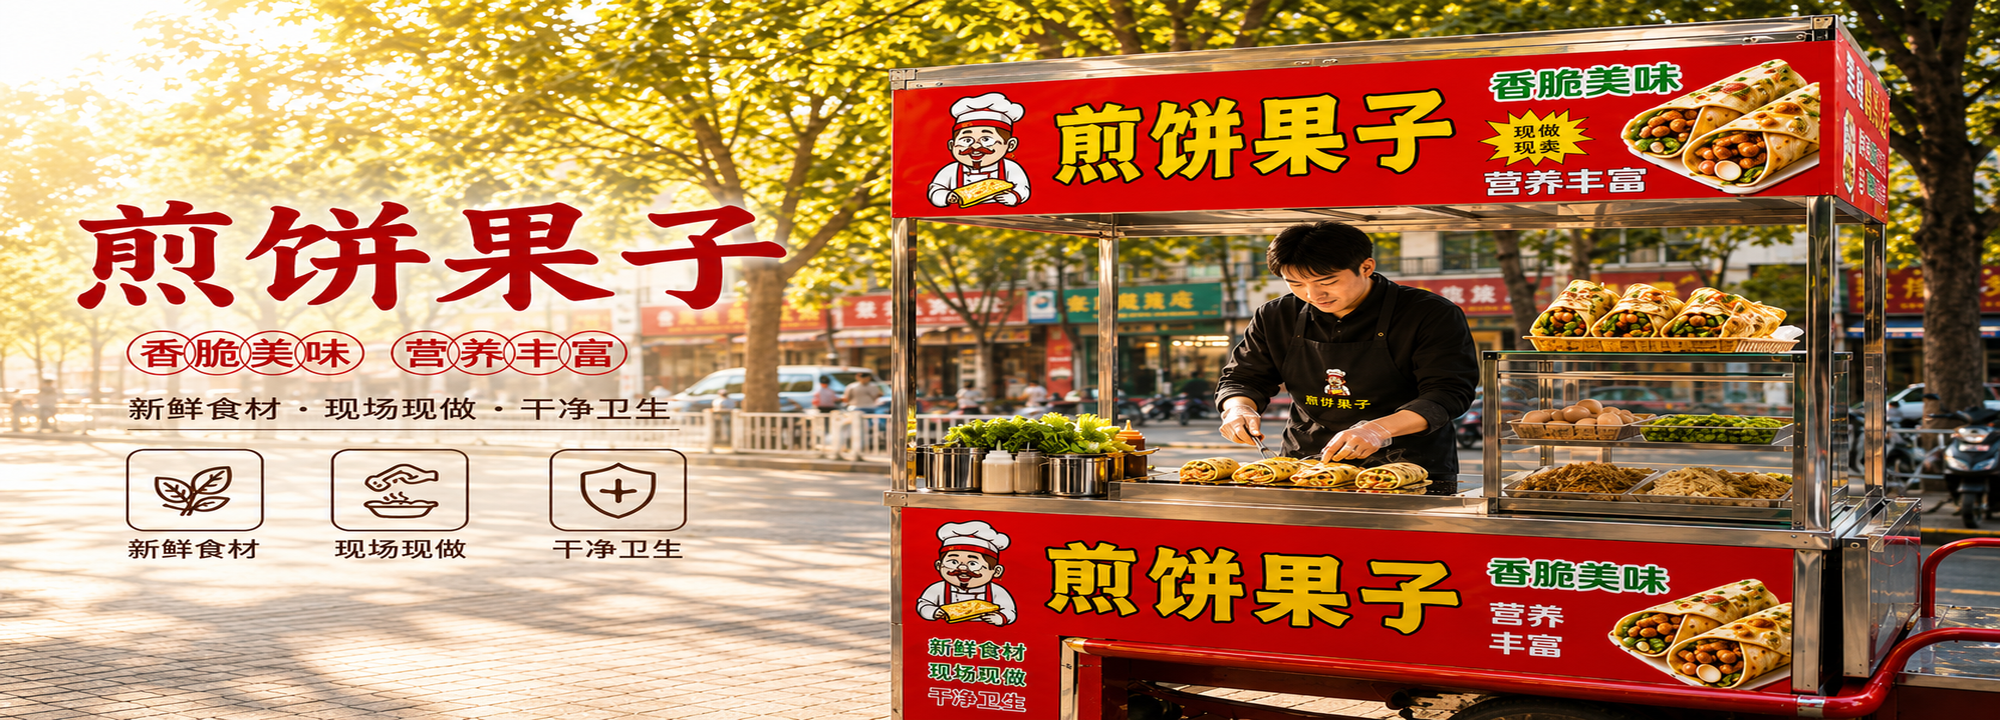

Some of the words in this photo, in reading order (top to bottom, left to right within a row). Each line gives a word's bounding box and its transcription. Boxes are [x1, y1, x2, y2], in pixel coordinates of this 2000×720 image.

[1489, 62, 1682, 101] 香脆美味
[1053, 89, 1456, 186] 煎饼果子
[1514, 124, 1560, 139] 现做
[1514, 140, 1560, 155] 现卖
[1484, 167, 1647, 196] 营养丰富
[1044, 540, 1463, 635] 煎饼果子
[1487, 557, 1670, 595] 香脆美味
[1489, 602, 1564, 628] 营养
[928, 637, 1027, 662] 新鲜食材
[1489, 631, 1563, 658] 丰富
[928, 662, 1027, 687] 现场现做
[928, 687, 1026, 712] 干净卫生
